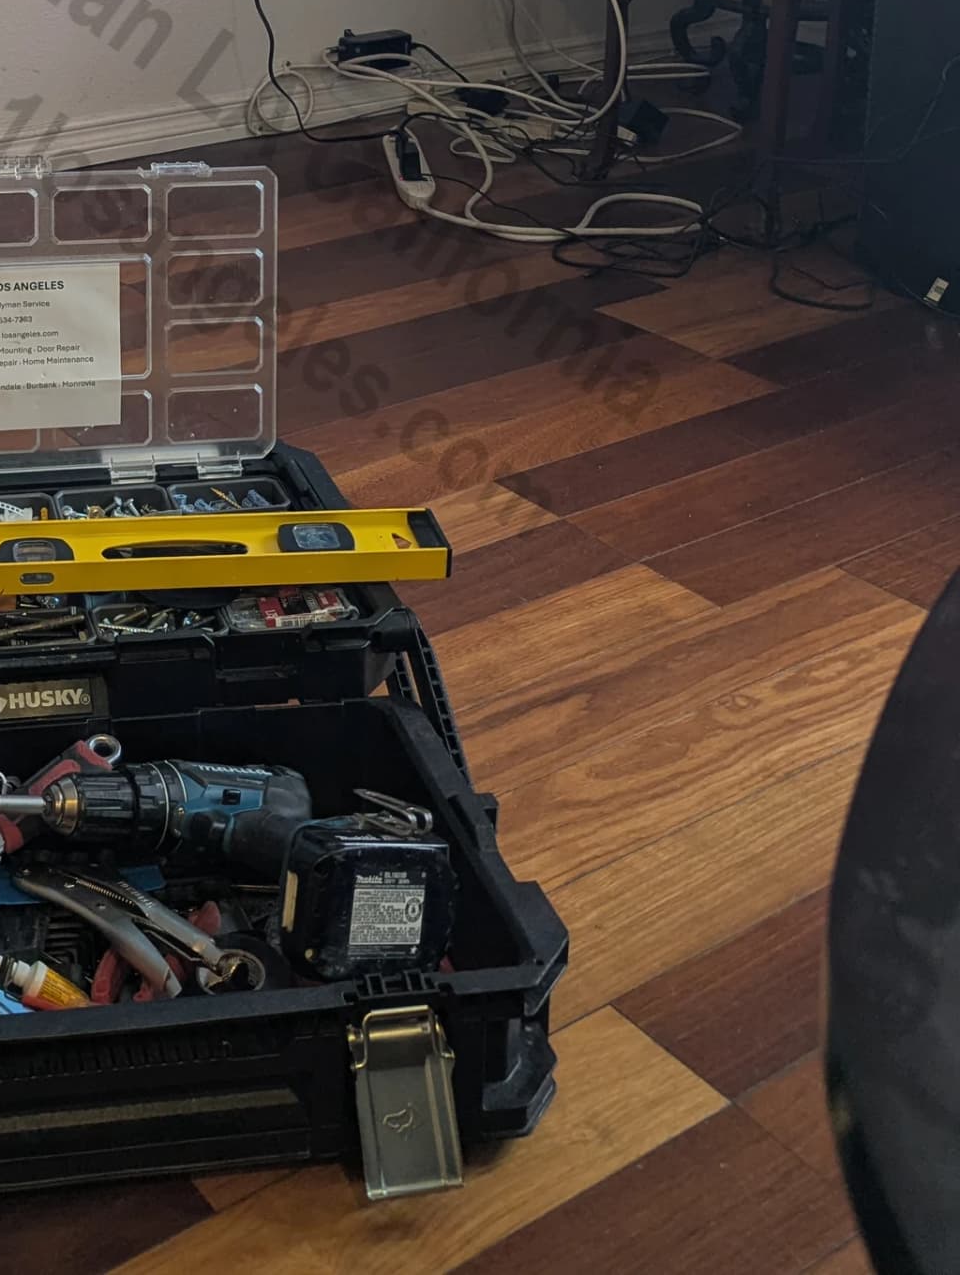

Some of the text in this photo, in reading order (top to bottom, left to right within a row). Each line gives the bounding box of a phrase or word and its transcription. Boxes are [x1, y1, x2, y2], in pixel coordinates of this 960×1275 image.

[13, 280, 64, 292] ANGELES
[36, 345, 55, 353] Door
[56, 344, 81, 353] Repair
[22, 357, 45, 365] Home
[46, 356, 94, 365] Maintenance
[9, 688, 84, 710] HUSKY
